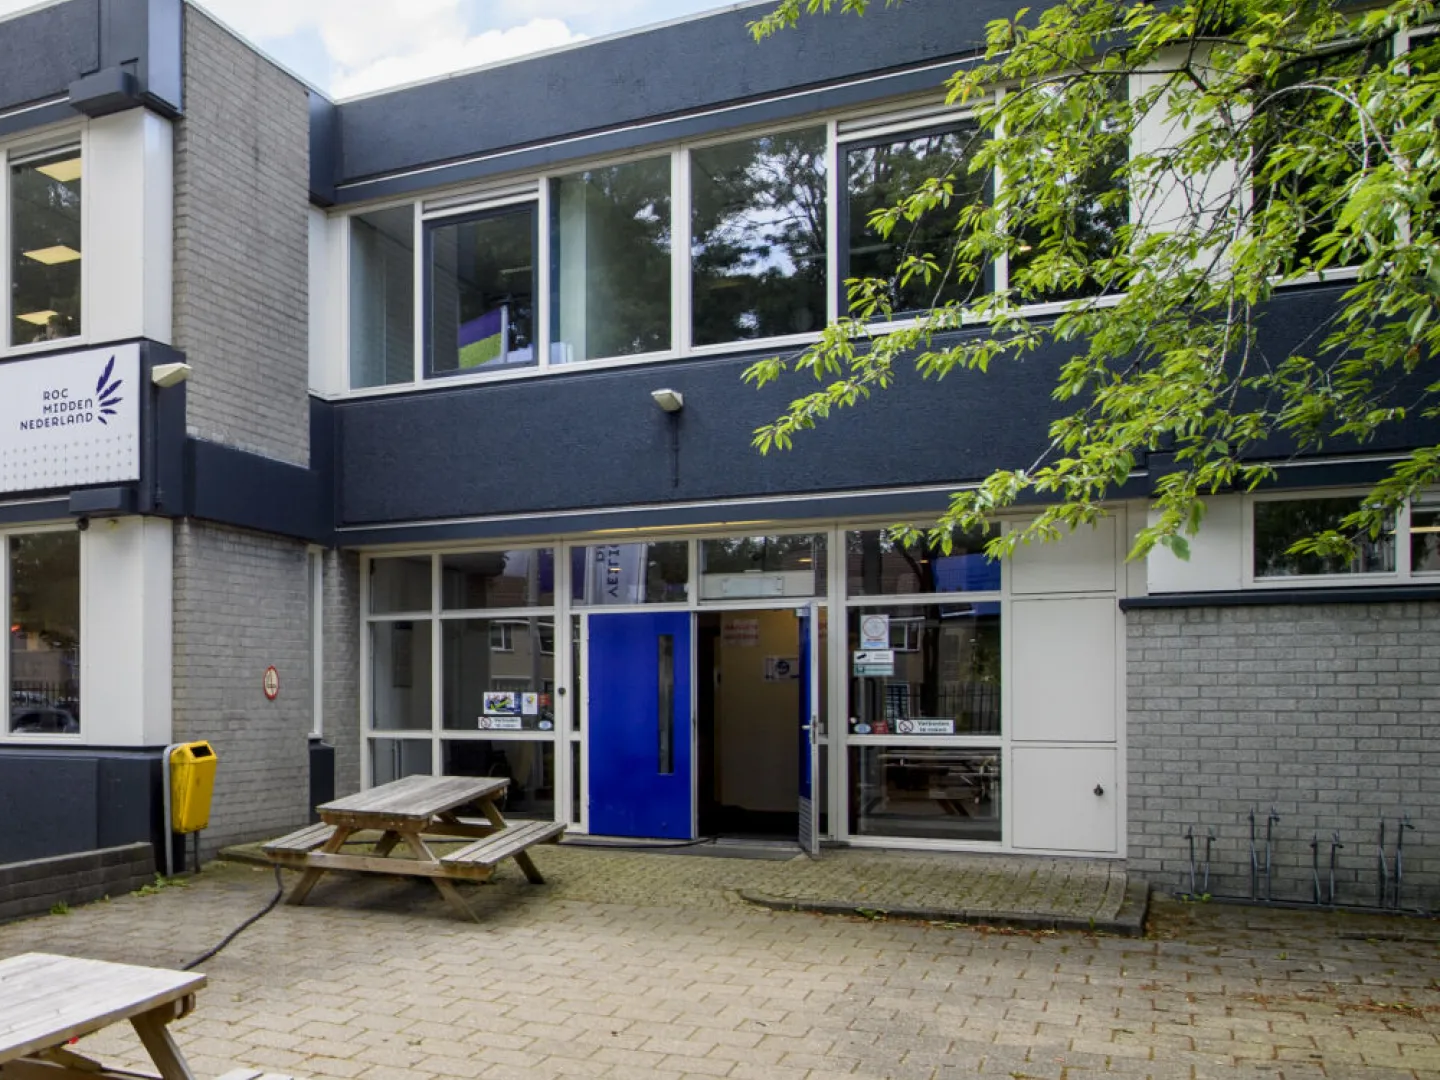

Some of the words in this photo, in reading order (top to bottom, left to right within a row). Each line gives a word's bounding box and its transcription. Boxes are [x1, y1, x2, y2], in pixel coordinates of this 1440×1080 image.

[42, 388, 69, 401] ROC
[42, 398, 93, 414] MIDDEN
[19, 412, 93, 430] NEDERLAND
